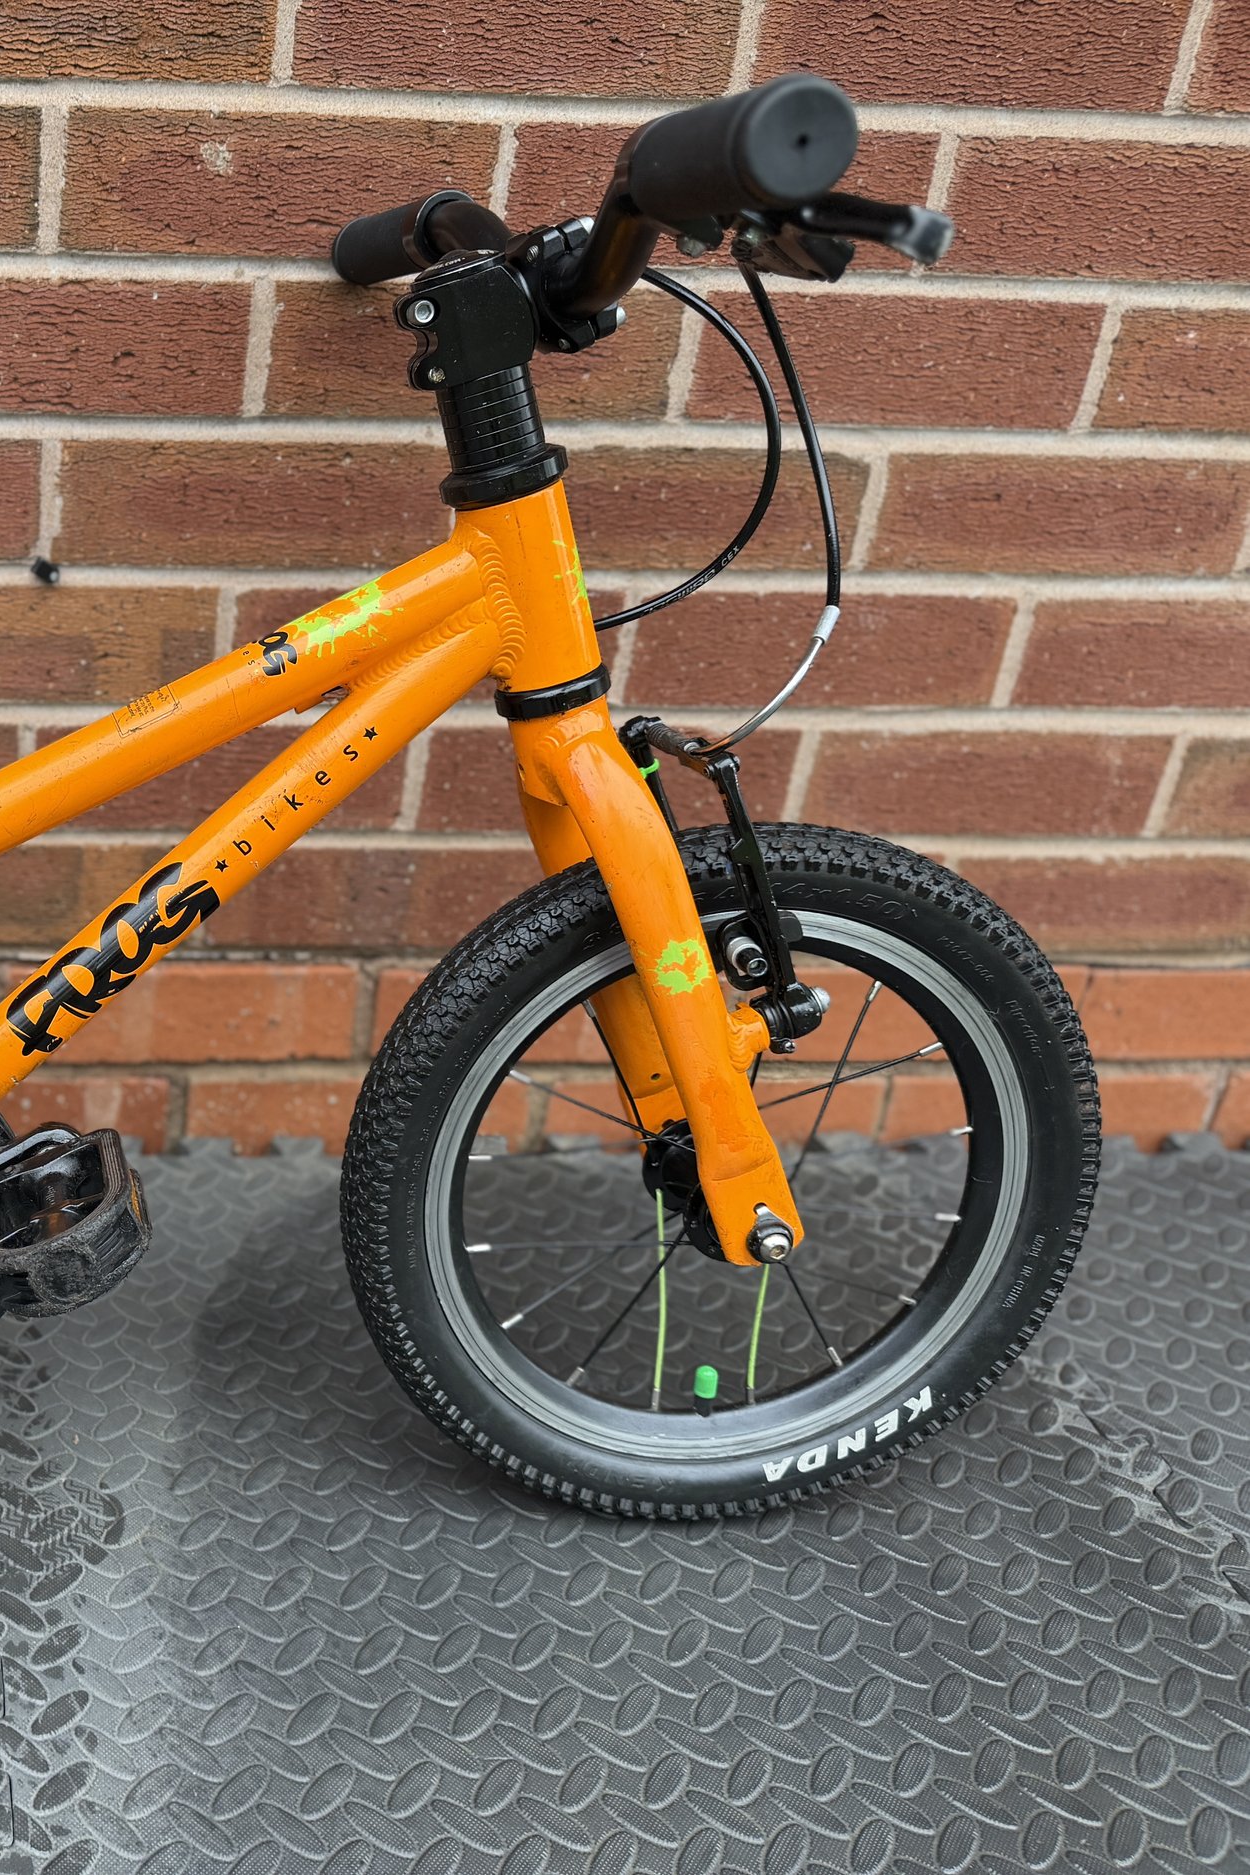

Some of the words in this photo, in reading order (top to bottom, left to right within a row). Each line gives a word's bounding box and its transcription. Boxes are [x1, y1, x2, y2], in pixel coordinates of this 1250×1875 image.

[721, 546, 739, 567] CEX
[252, 631, 298, 676] OG
[6, 861, 222, 1057] FROG
[232, 744, 359, 856] bikes
[762, 1385, 933, 1483] KENDA
